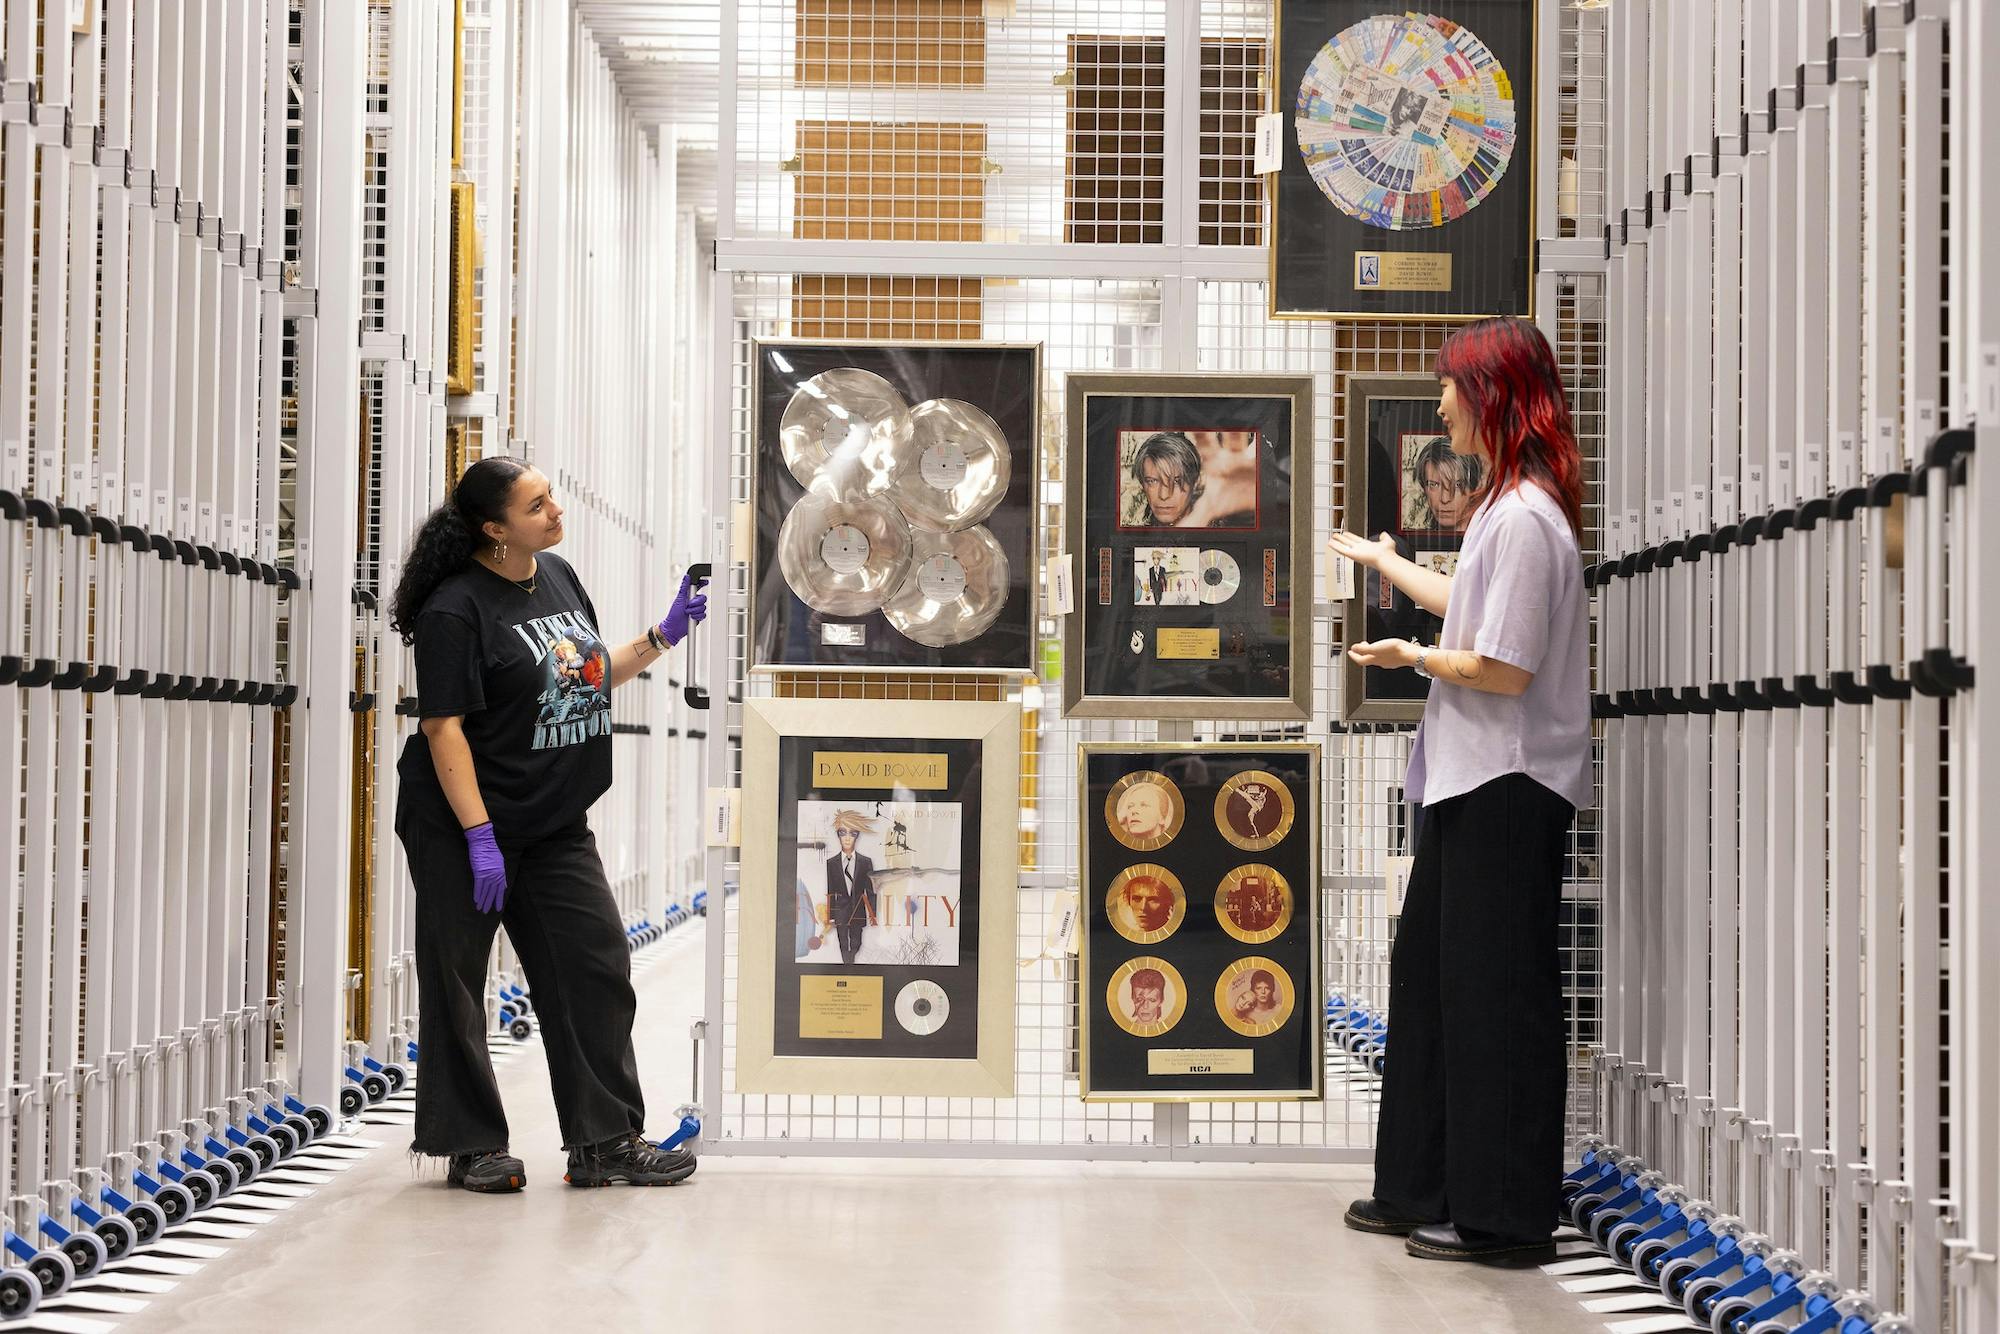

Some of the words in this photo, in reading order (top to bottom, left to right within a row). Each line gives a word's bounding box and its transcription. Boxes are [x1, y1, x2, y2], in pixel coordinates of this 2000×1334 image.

[512, 610, 607, 666] LEWIS
[536, 689, 558, 705] 44
[820, 763, 878, 777] DAVID
[884, 763, 941, 778] BOWIE
